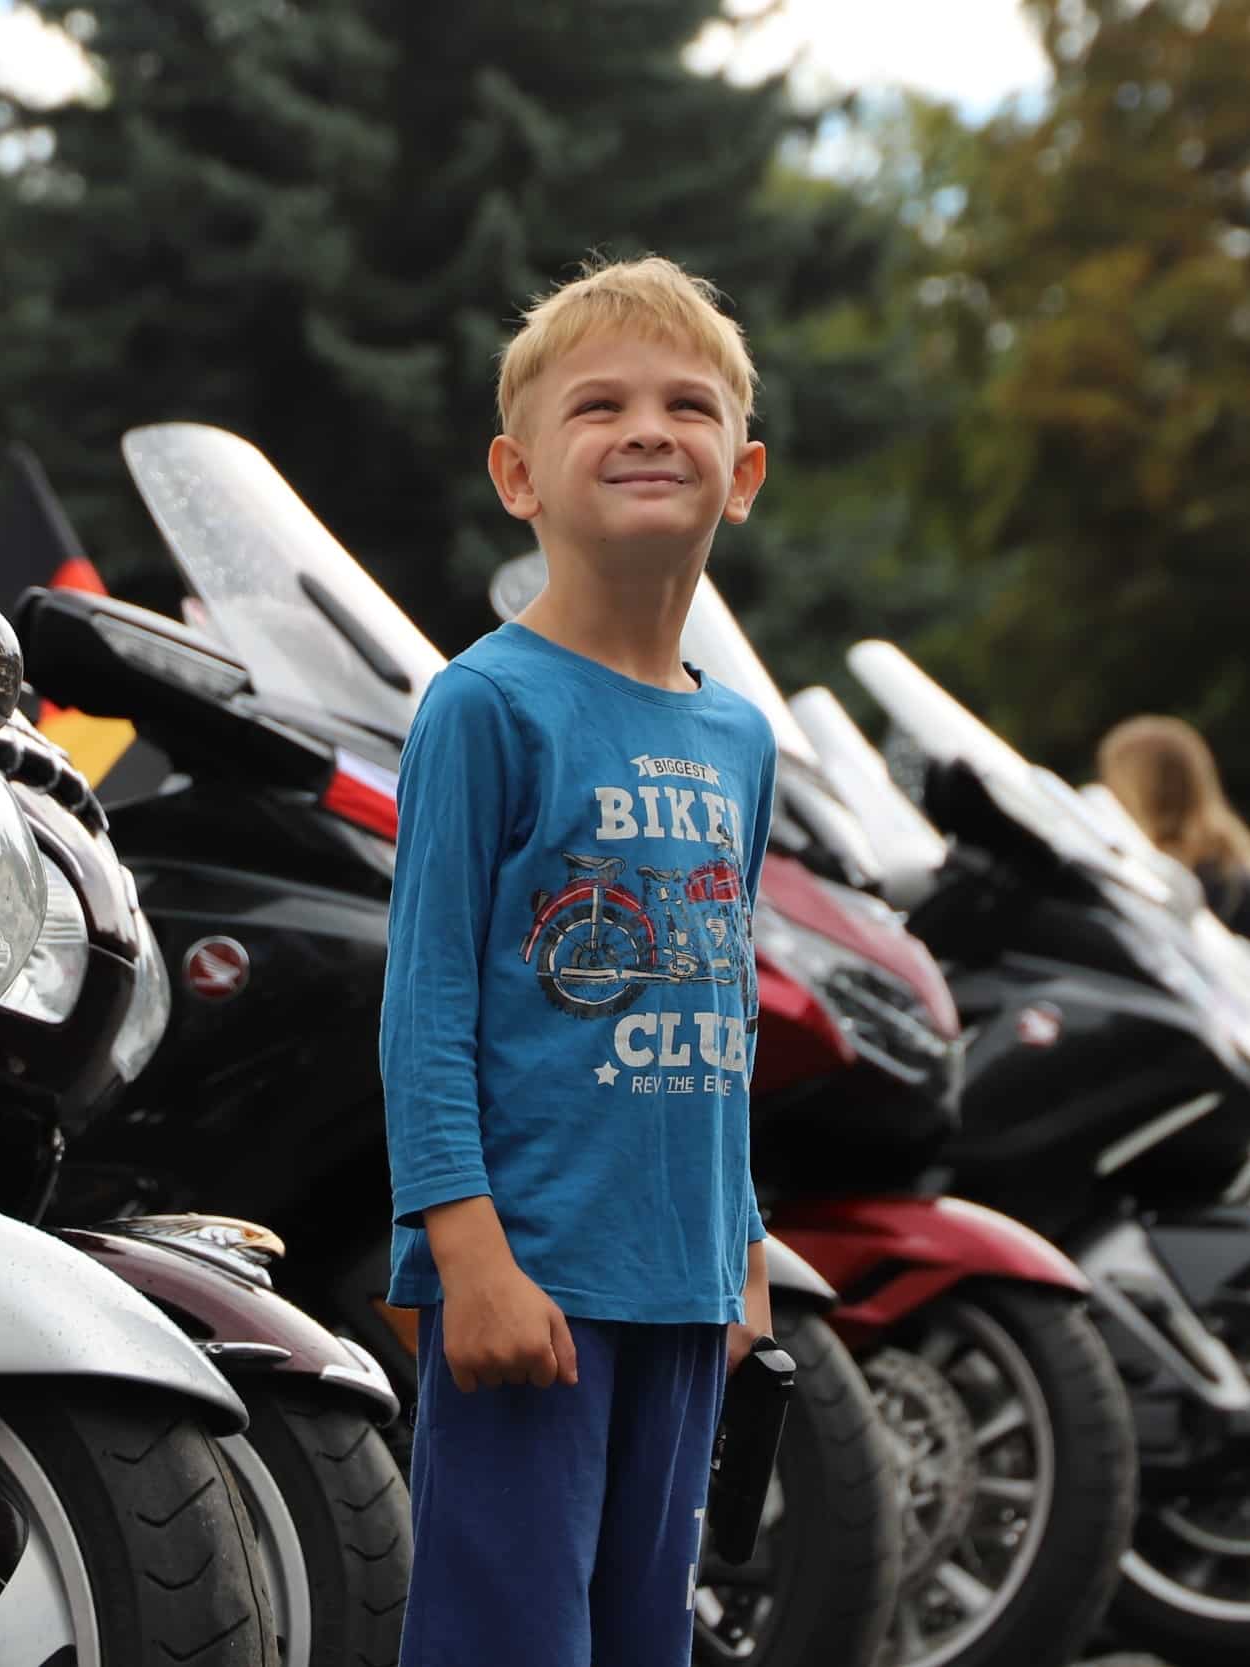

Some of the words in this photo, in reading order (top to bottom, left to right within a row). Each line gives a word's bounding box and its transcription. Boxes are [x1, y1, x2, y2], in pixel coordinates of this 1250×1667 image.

[653, 760, 707, 779] BIGGEST
[631, 1075, 662, 1094] REV
[666, 1076, 695, 1093] THE
